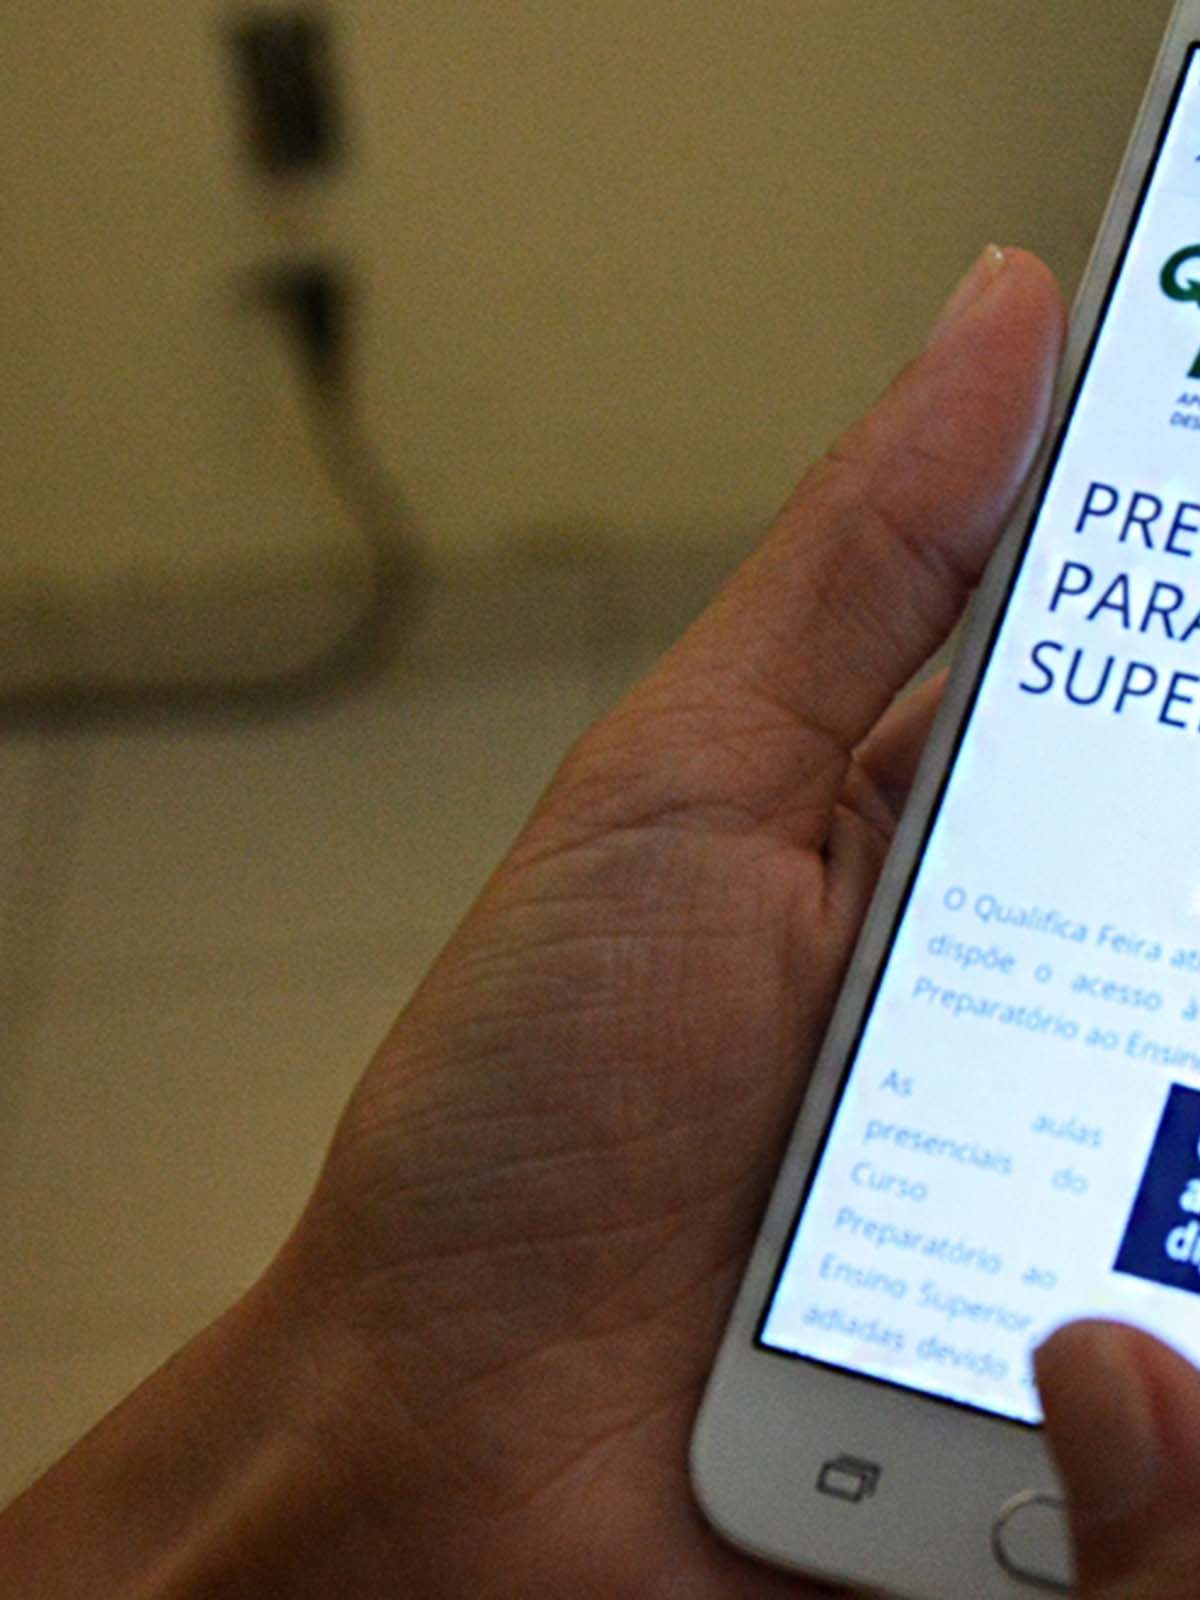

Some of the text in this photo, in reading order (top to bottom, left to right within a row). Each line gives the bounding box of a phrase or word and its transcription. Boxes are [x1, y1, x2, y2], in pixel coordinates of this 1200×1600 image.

[943, 886, 967, 911] O
[974, 893, 1088, 942] Qualifica
[1097, 923, 1163, 961] Feira
[927, 934, 1016, 975] dispõe
[1033, 963, 1052, 983] o
[1070, 973, 1163, 1011] acesso
[912, 974, 1079, 1039] Preparatório
[1085, 1028, 1119, 1051] ao
[880, 1068, 1103, 1148] As aulas
[851, 1161, 928, 1201] Curso
[863, 1118, 1088, 1194] presenciais do
[819, 1252, 908, 1299] Ensino
[835, 1206, 1058, 1289] Preparatório ao
[804, 1304, 905, 1349] adiadas
[917, 1336, 1009, 1378] devido
